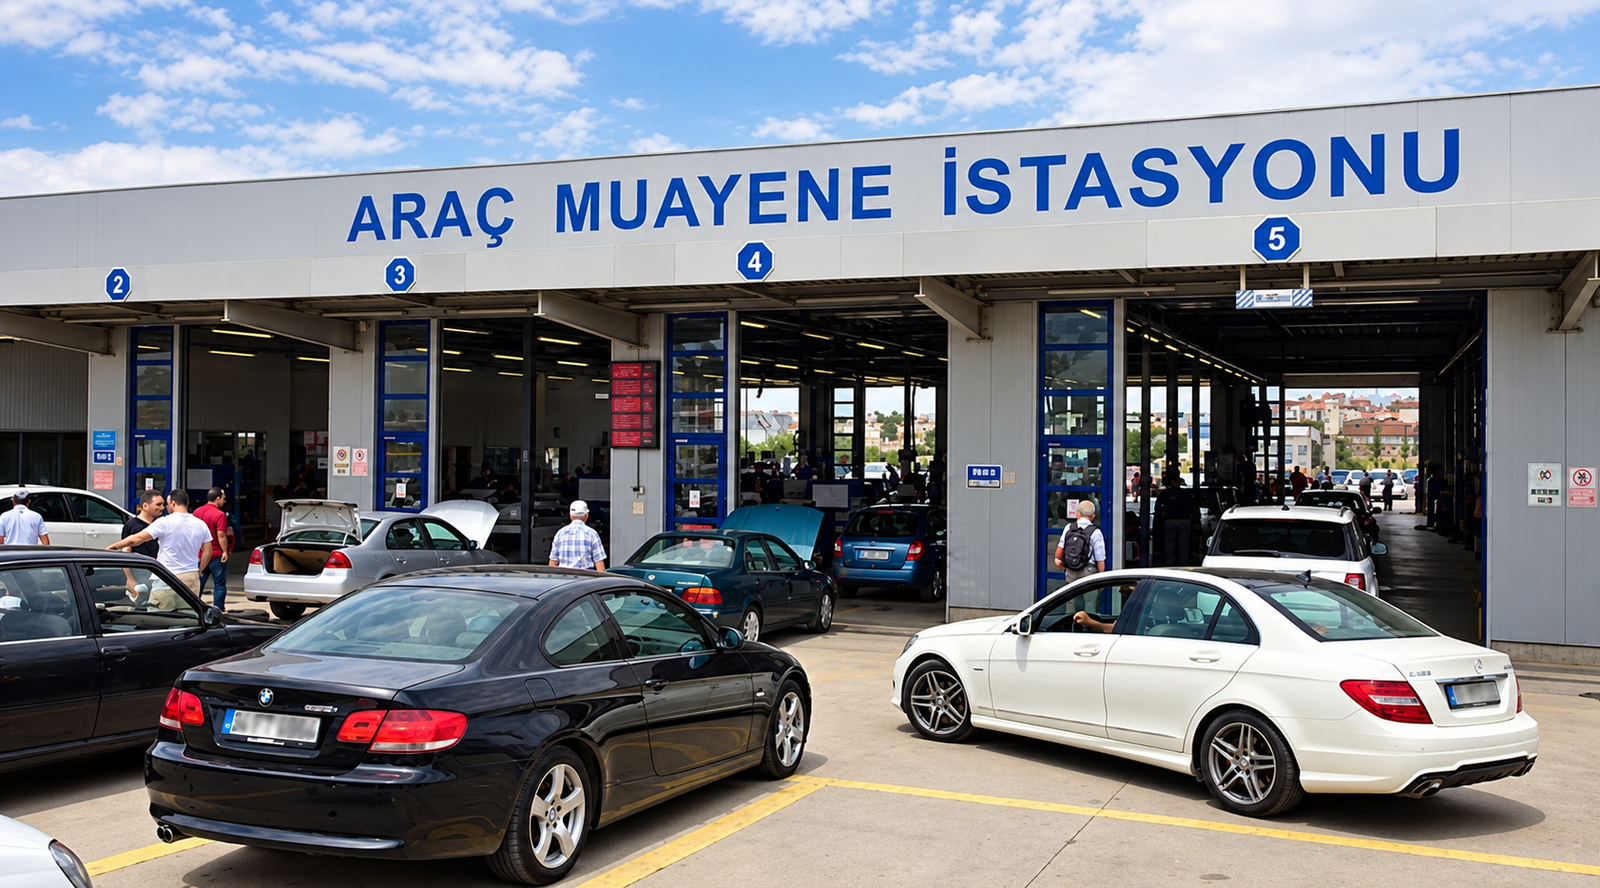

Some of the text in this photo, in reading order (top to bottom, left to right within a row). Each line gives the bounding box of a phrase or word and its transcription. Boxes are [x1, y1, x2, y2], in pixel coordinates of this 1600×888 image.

[347, 128, 1460, 249] ARAÇ MUAYENE İSTASYONU
[1268, 226, 1286, 251] 5
[747, 251, 762, 272] 4
[112, 275, 123, 293] 2
[394, 265, 406, 284] 3
